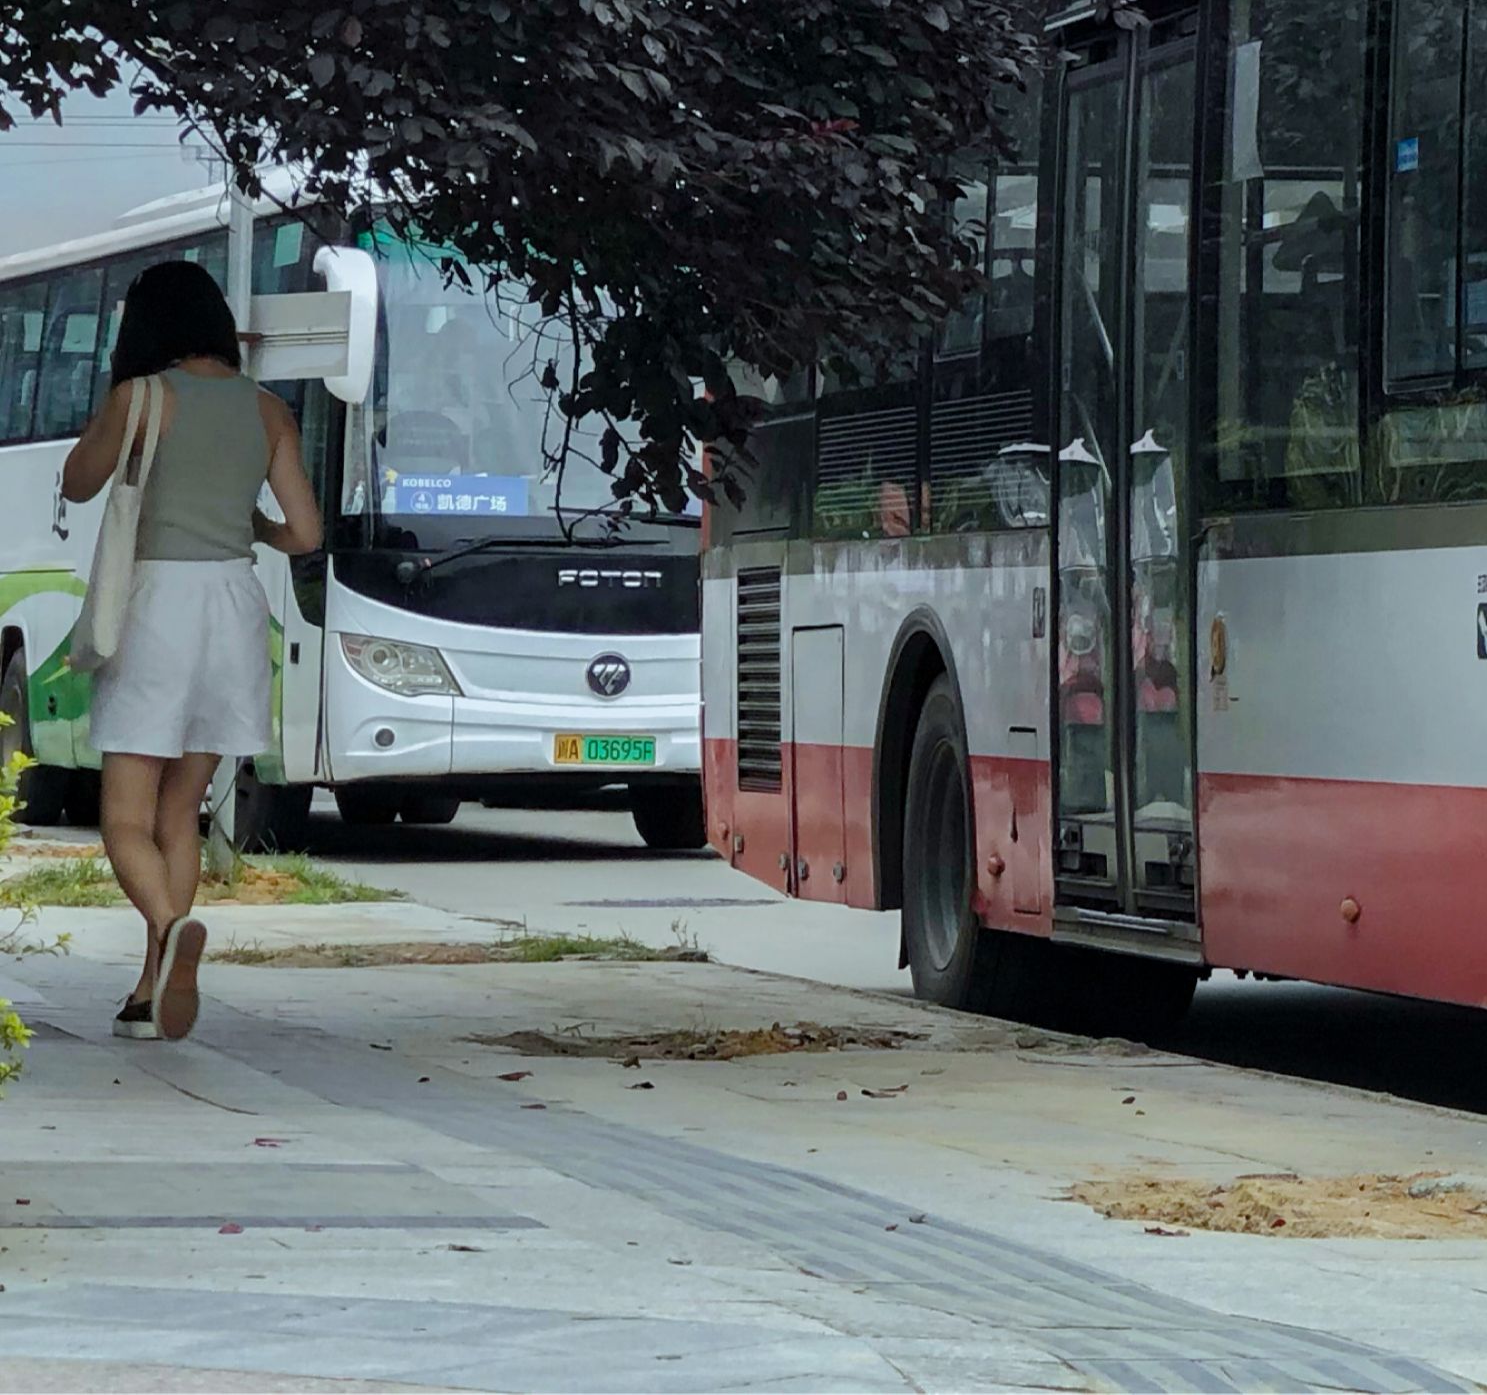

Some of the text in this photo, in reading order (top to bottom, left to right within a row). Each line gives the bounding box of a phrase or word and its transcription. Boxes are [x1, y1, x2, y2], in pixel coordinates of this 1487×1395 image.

[402, 478, 452, 488] KOBELCO
[437, 494, 507, 512] 凯德广场
[558, 569, 663, 588] FOTON
